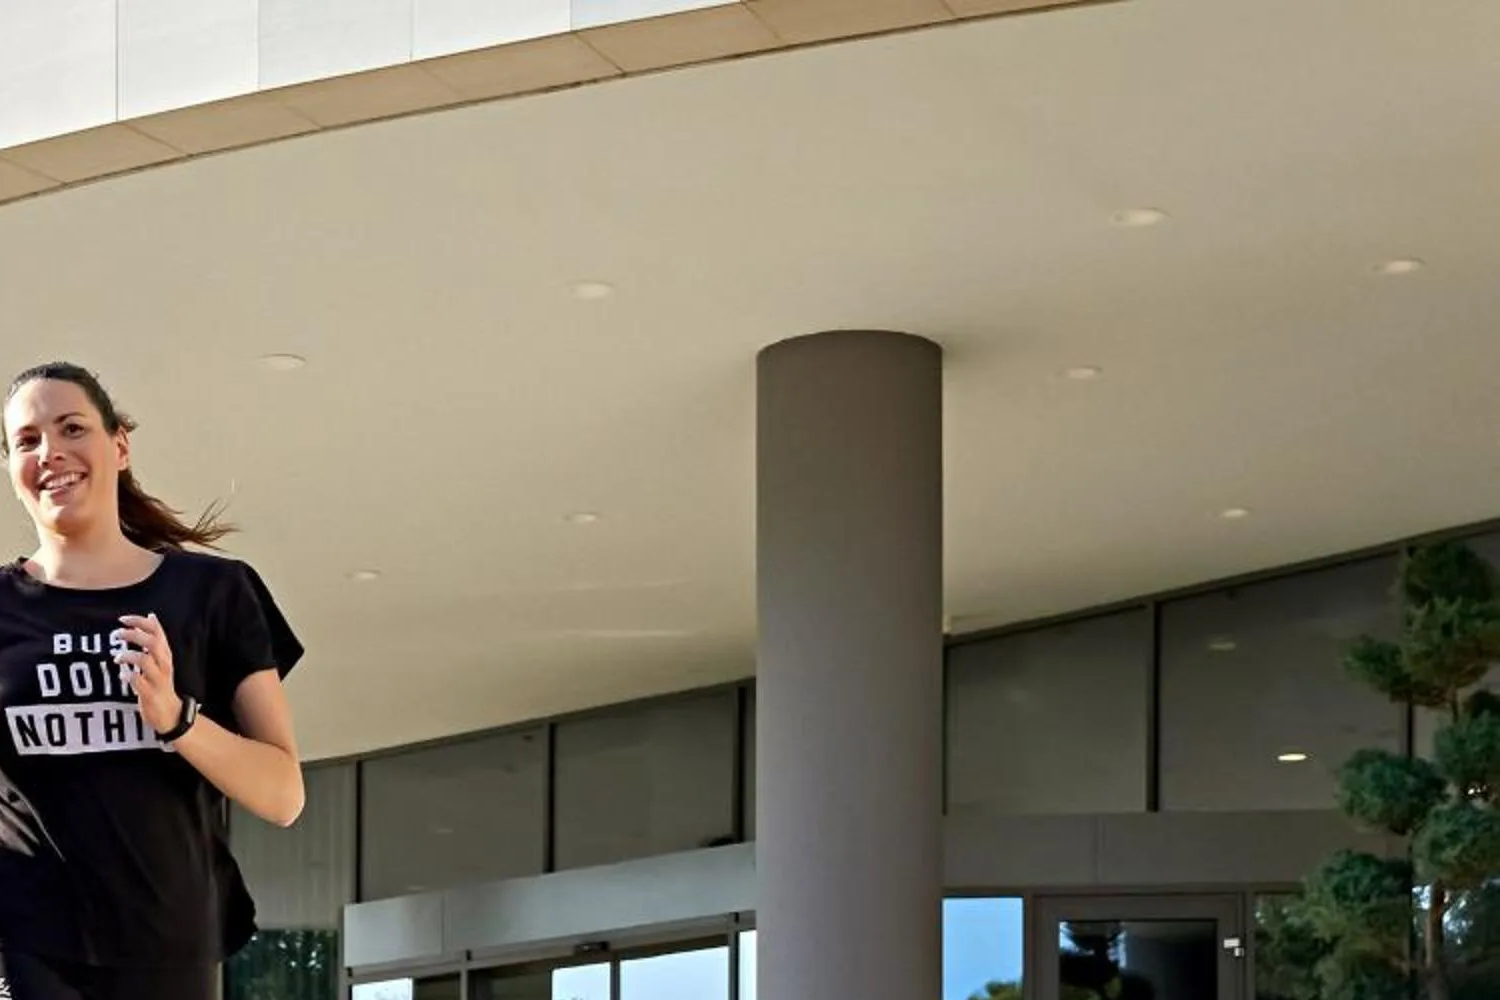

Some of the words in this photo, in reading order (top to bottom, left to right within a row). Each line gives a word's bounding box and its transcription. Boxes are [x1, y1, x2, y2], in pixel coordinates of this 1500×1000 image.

[53, 628, 129, 657] BUS
[36, 661, 141, 698] DOIN
[15, 709, 144, 748] NOTHI
